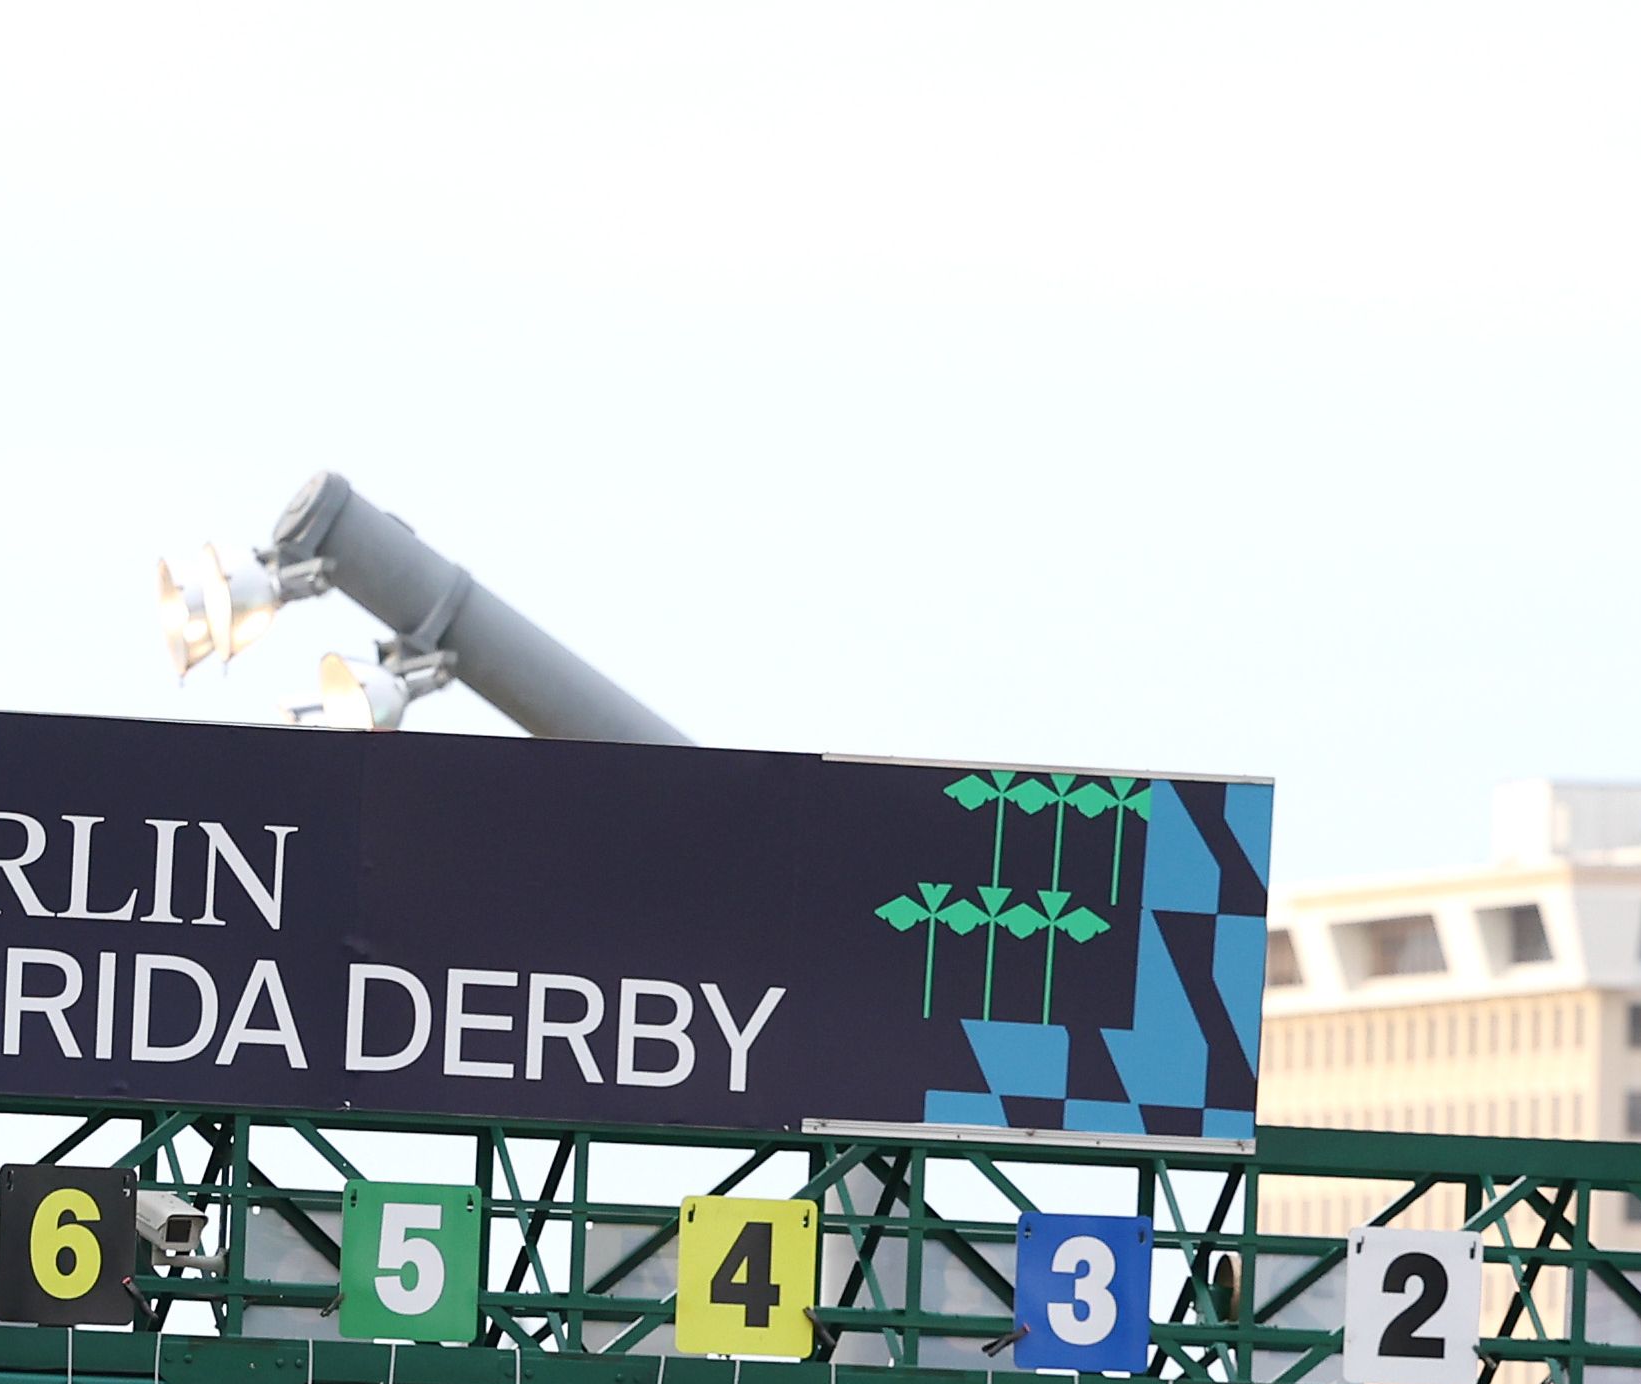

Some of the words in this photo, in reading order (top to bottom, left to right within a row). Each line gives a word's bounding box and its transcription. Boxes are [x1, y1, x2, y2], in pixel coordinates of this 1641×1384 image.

[345, 963, 787, 1092] DERBY
[32, 1188, 101, 1298] 6
[374, 1202, 445, 1316] 5
[709, 1221, 781, 1328] 4
[1046, 1235, 1117, 1346] 3
[1378, 1252, 1449, 1359] 2
